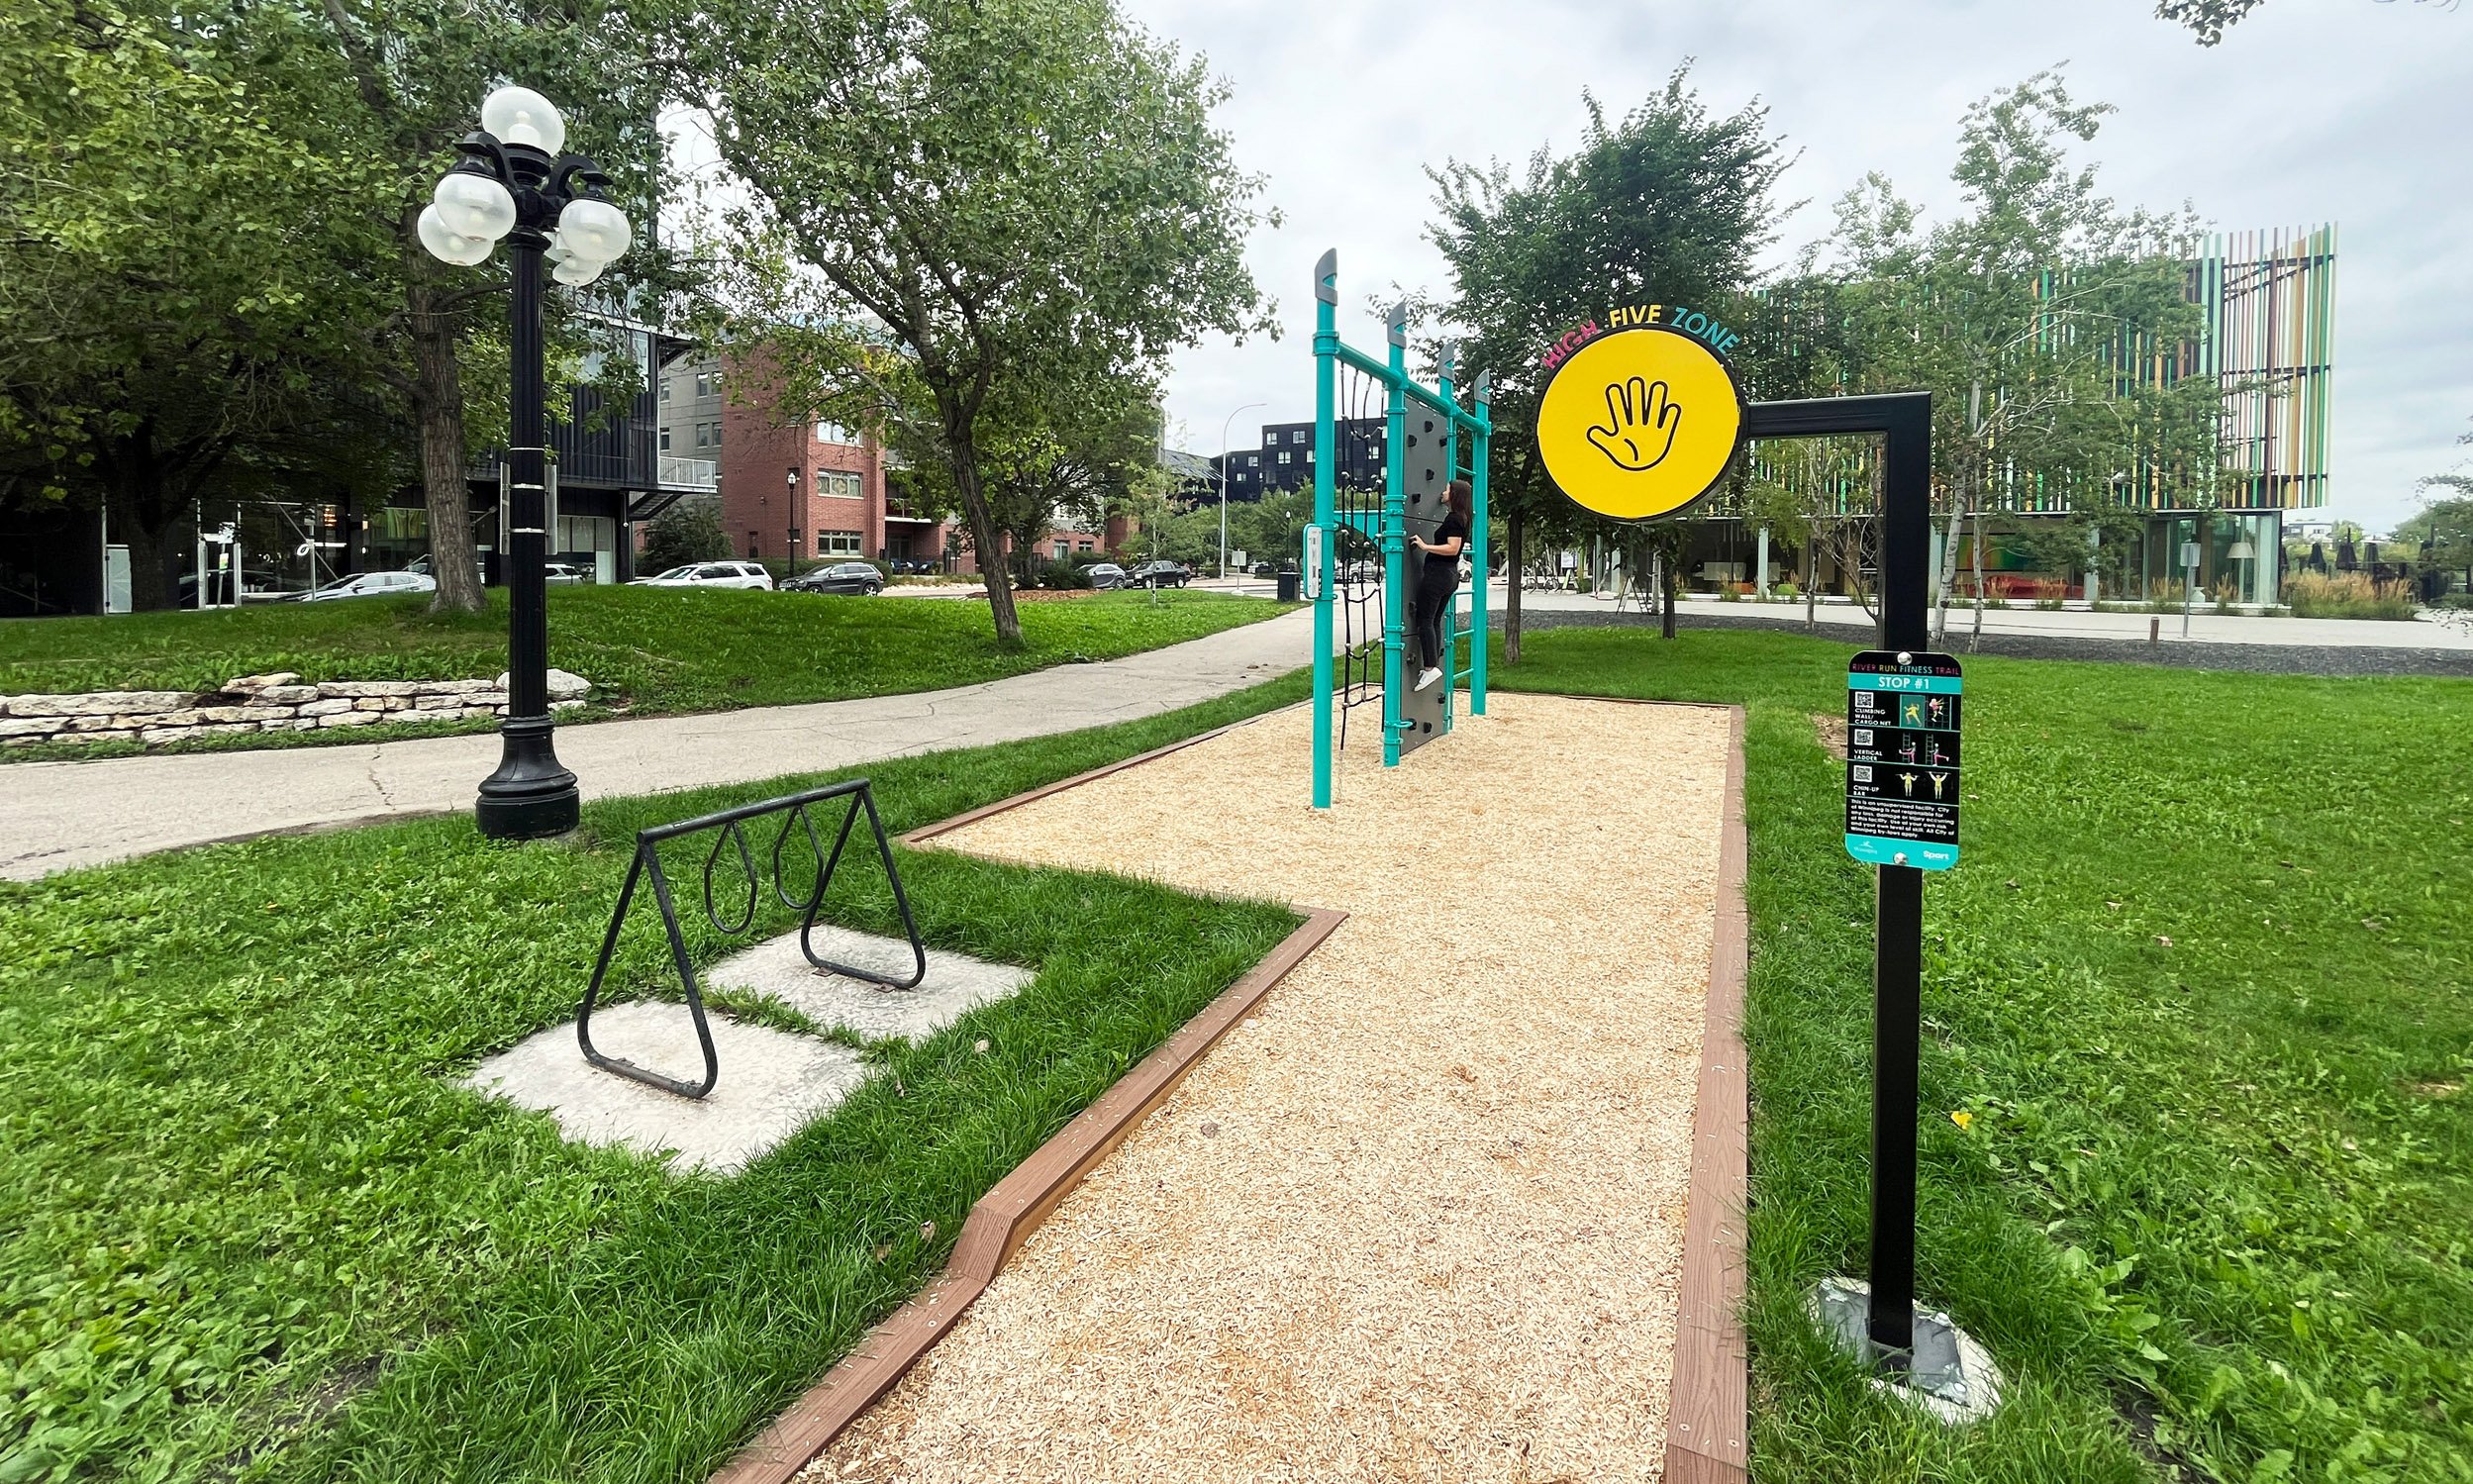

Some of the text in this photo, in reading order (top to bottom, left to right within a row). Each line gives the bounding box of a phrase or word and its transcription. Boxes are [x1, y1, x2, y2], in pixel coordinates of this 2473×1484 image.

[1541, 305, 1740, 369] HIGH FIVE ZONE
[1900, 665, 1932, 674] FITNESS
[1935, 666, 1959, 675] TRAIL
[1878, 676, 1929, 690] STOP #1
[1923, 850, 1949, 860] Sport
